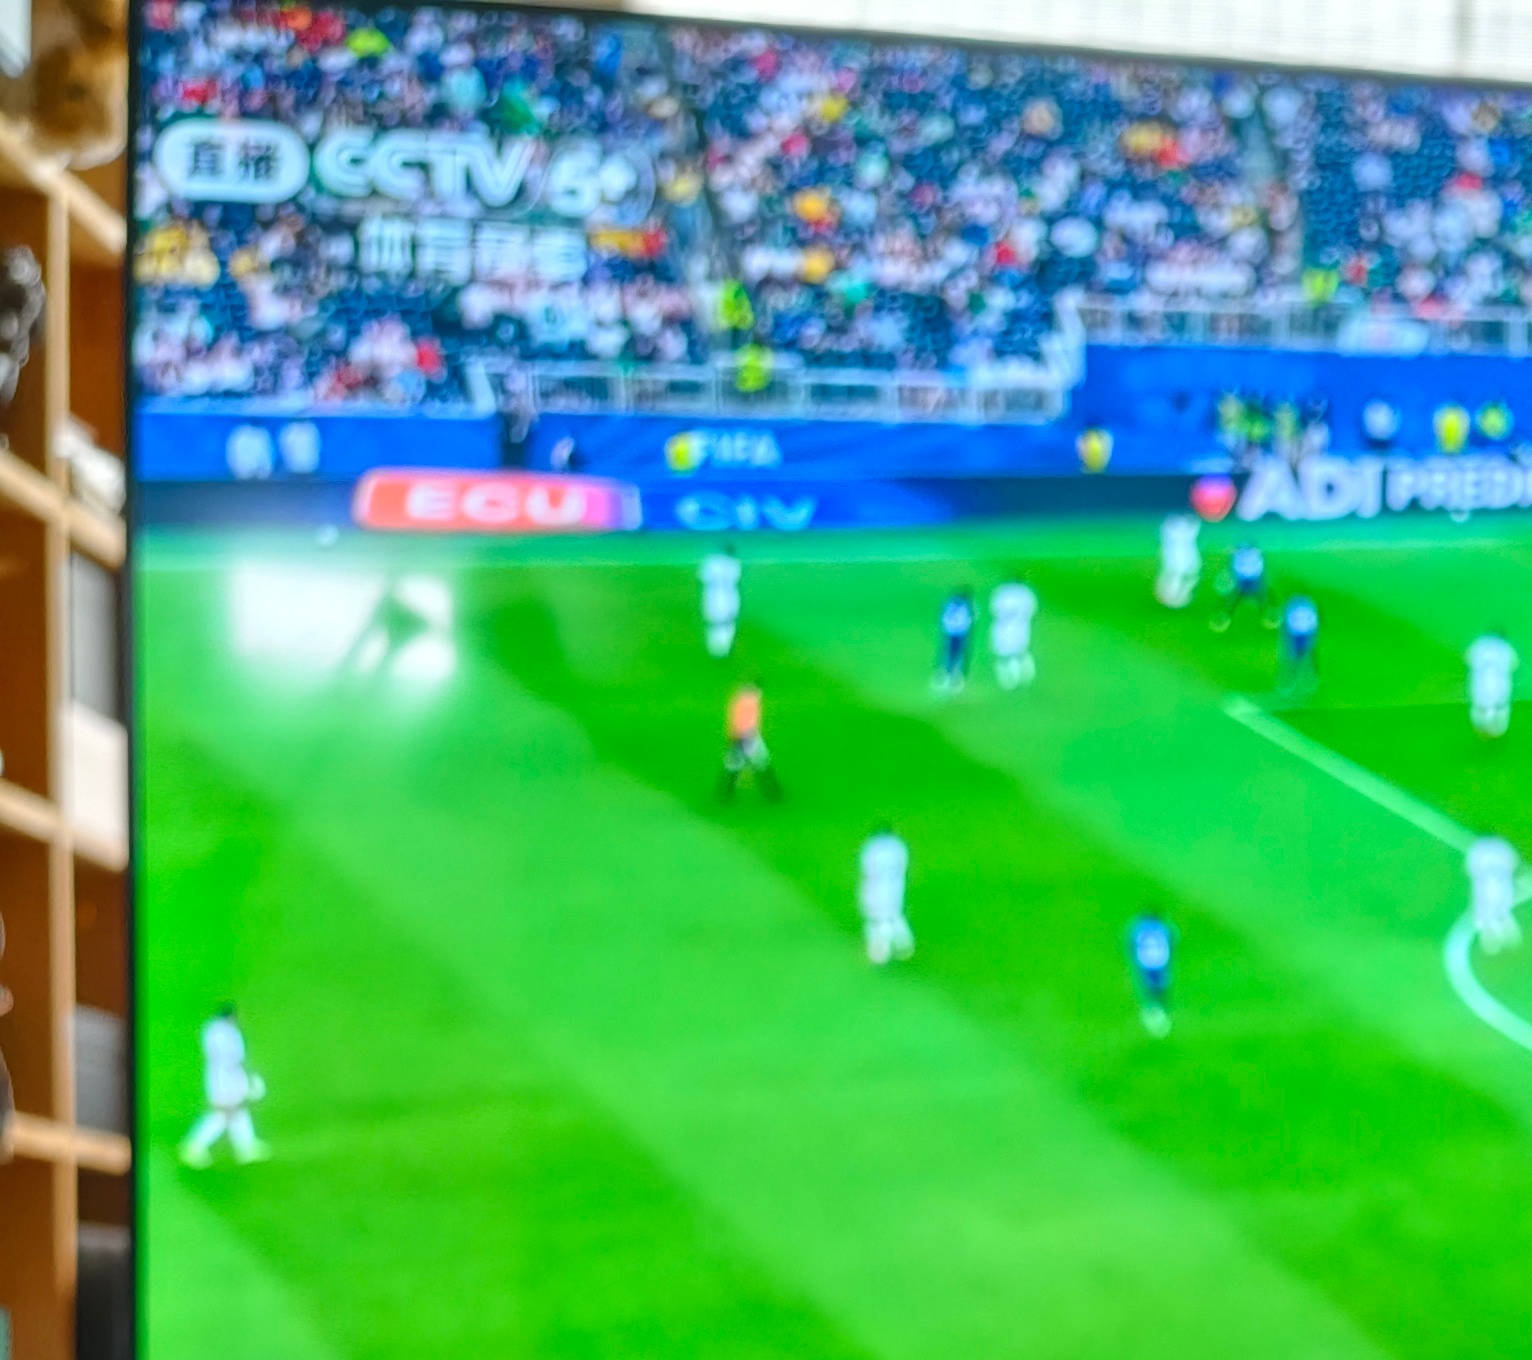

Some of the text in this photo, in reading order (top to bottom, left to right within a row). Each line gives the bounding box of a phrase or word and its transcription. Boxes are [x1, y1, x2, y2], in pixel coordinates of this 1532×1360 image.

[186, 140, 280, 182] 直播
[404, 482, 818, 532] ECU CIV
[1235, 457, 1386, 522] ADI
